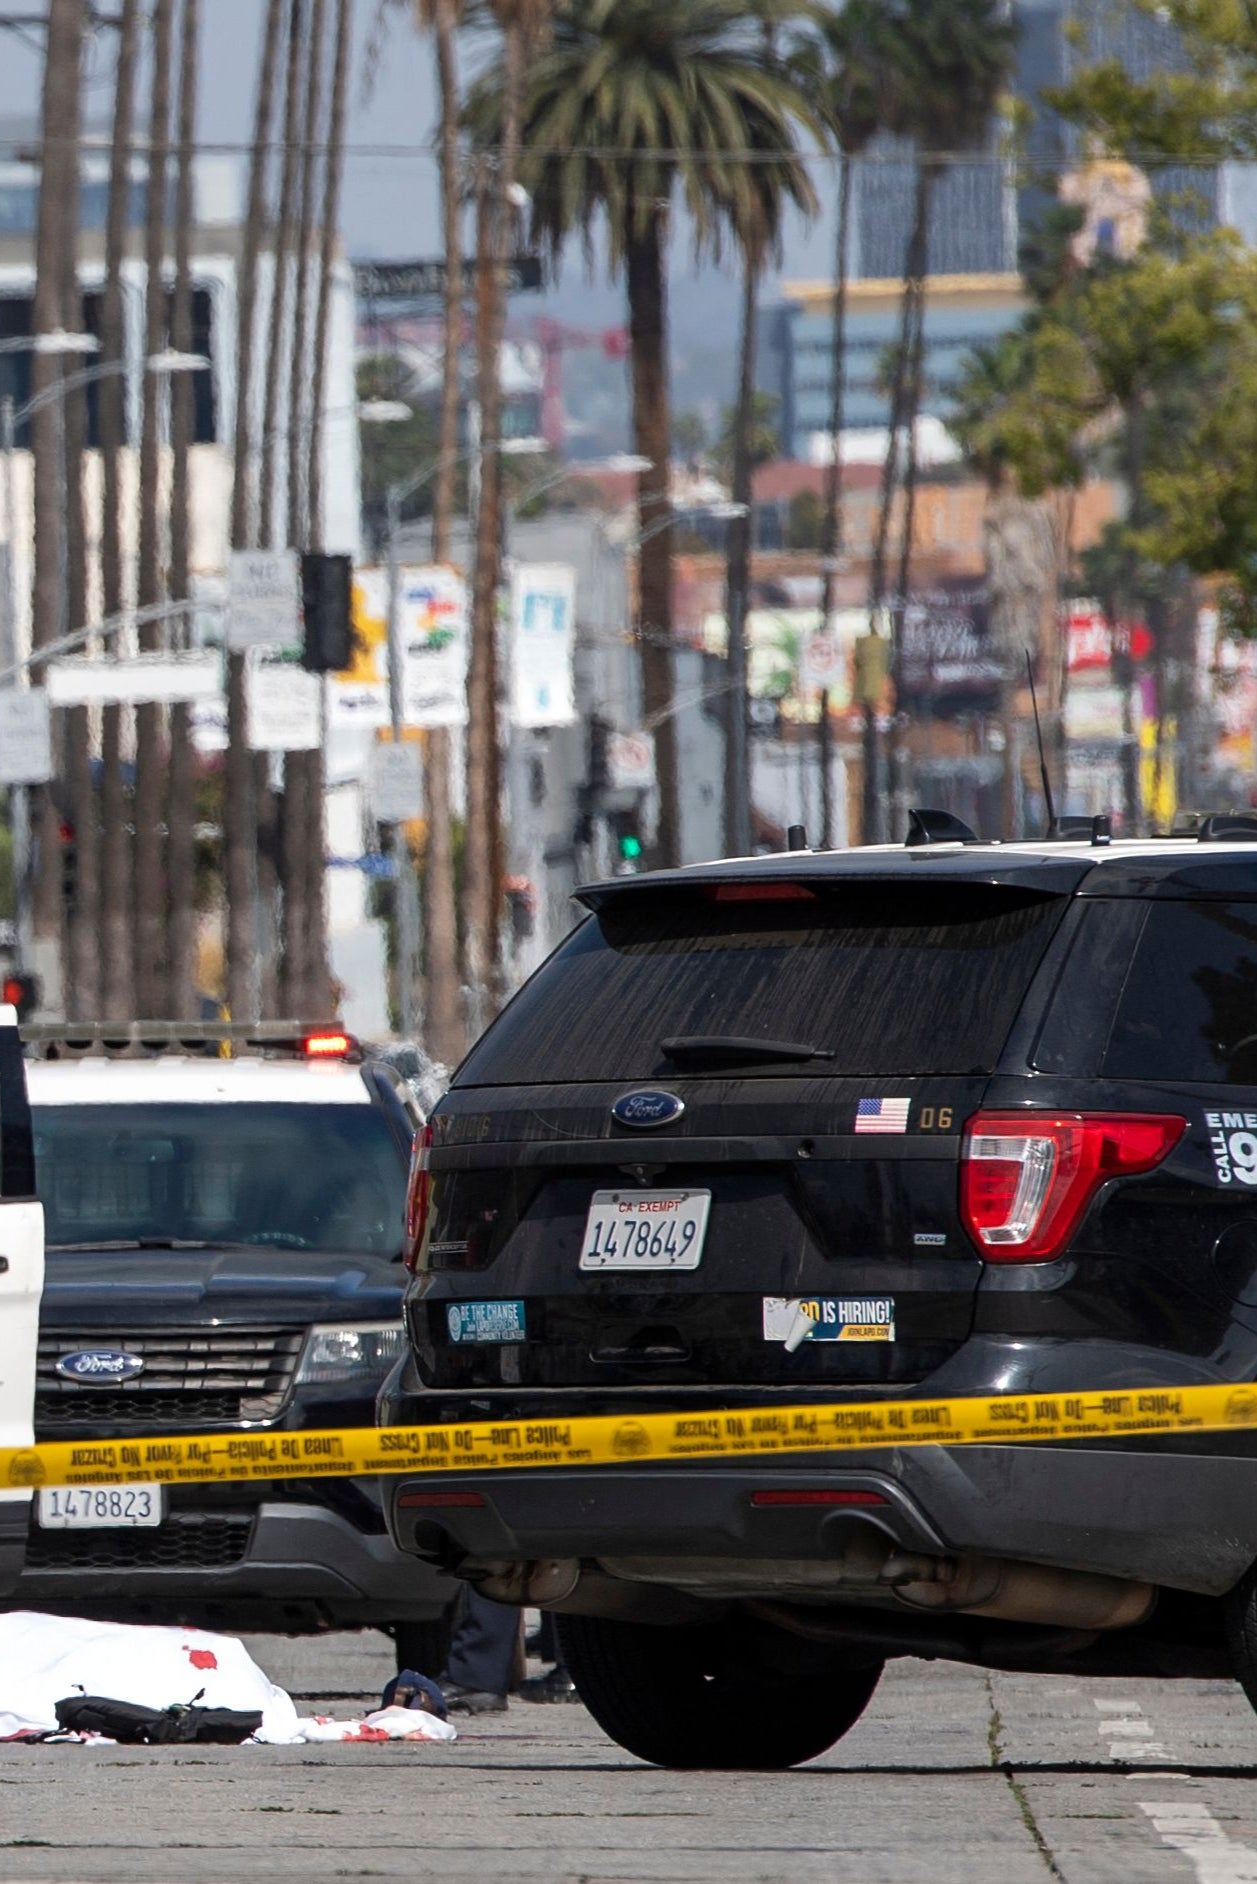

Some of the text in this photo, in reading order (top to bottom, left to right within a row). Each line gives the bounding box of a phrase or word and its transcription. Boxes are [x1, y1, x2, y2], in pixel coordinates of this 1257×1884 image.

[625, 1096, 664, 1118] Ford
[920, 1108, 953, 1129] 06
[1211, 1130, 1232, 1183] CALL
[619, 1201, 681, 1213] CA EXEMPT
[588, 1221, 696, 1257] 1478649
[471, 1304, 485, 1320] THE
[486, 1303, 518, 1320] CHANGE
[823, 1301, 836, 1323] IS
[838, 1301, 890, 1323] HIRING!
[75, 1355, 124, 1372] Ford
[71, 1446, 116, 1467] Cruzar
[121, 1444, 140, 1467] No
[145, 1442, 182, 1464] Favor
[281, 1437, 299, 1460] De
[50, 1491, 151, 1517] 1478823
